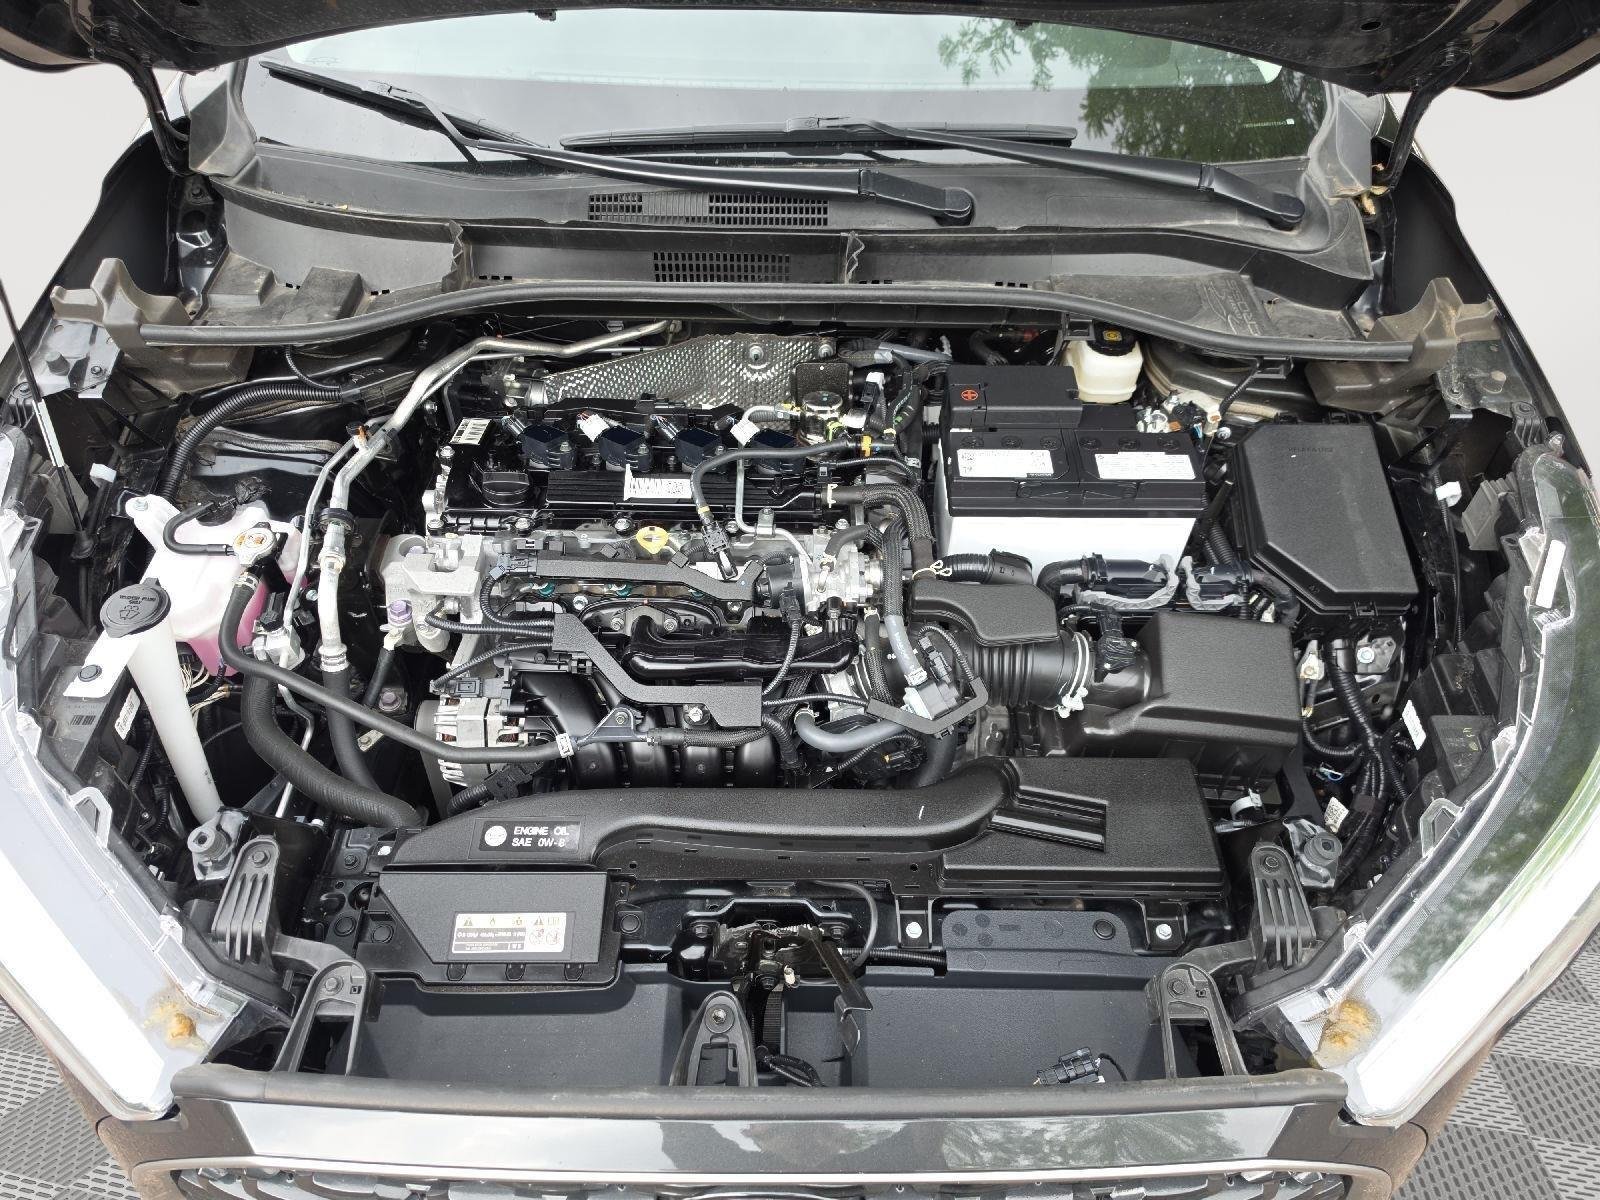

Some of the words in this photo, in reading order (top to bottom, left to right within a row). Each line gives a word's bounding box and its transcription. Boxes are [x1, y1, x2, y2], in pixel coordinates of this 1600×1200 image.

[513, 826, 549, 836] ENGINE
[553, 826, 570, 836] OIL
[511, 838, 532, 847] SAE
